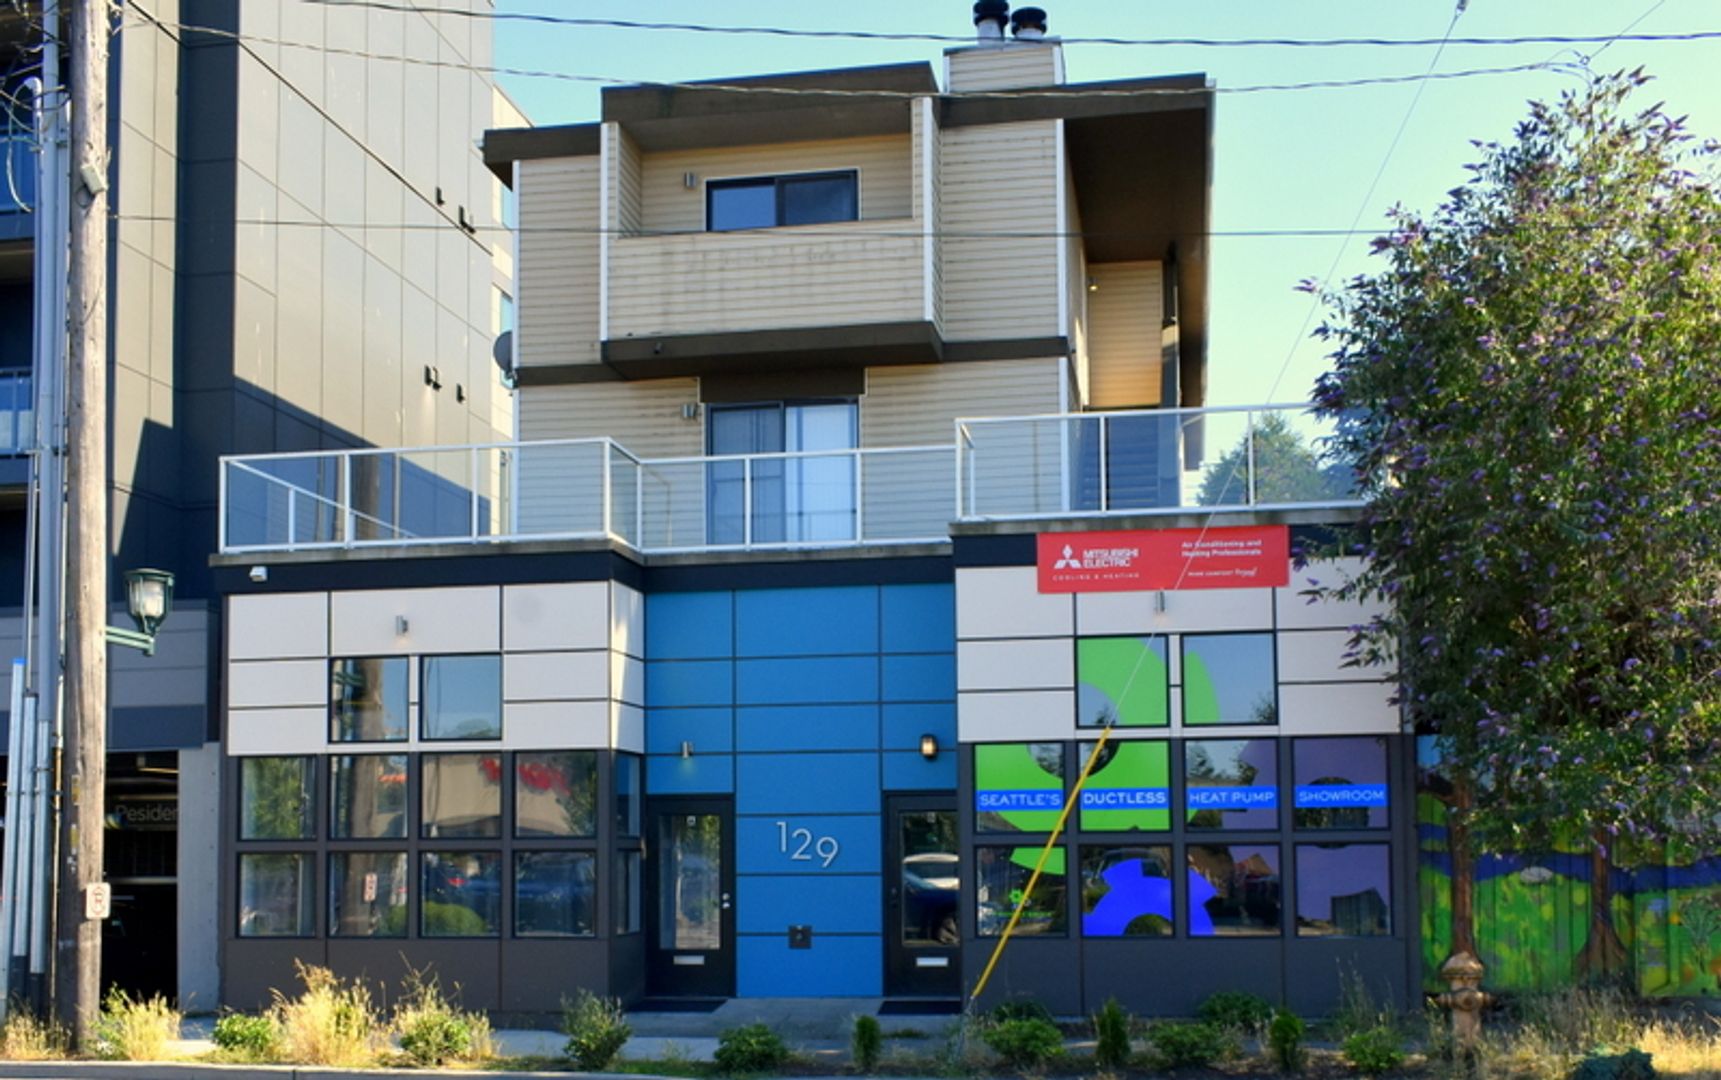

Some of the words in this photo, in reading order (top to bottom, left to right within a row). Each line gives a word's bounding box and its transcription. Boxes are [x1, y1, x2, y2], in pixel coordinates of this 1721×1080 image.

[1083, 548, 1139, 558] MITSUBISHI
[1083, 558, 1131, 569] ELECTRIC
[979, 793, 1061, 807] SEATTLE'S
[1083, 791, 1166, 805] DUCTLESS
[1189, 791, 1227, 804] HEAT
[1233, 790, 1275, 803] PUMP
[1299, 789, 1384, 803] SHOWROOM
[776, 821, 839, 868] 129
